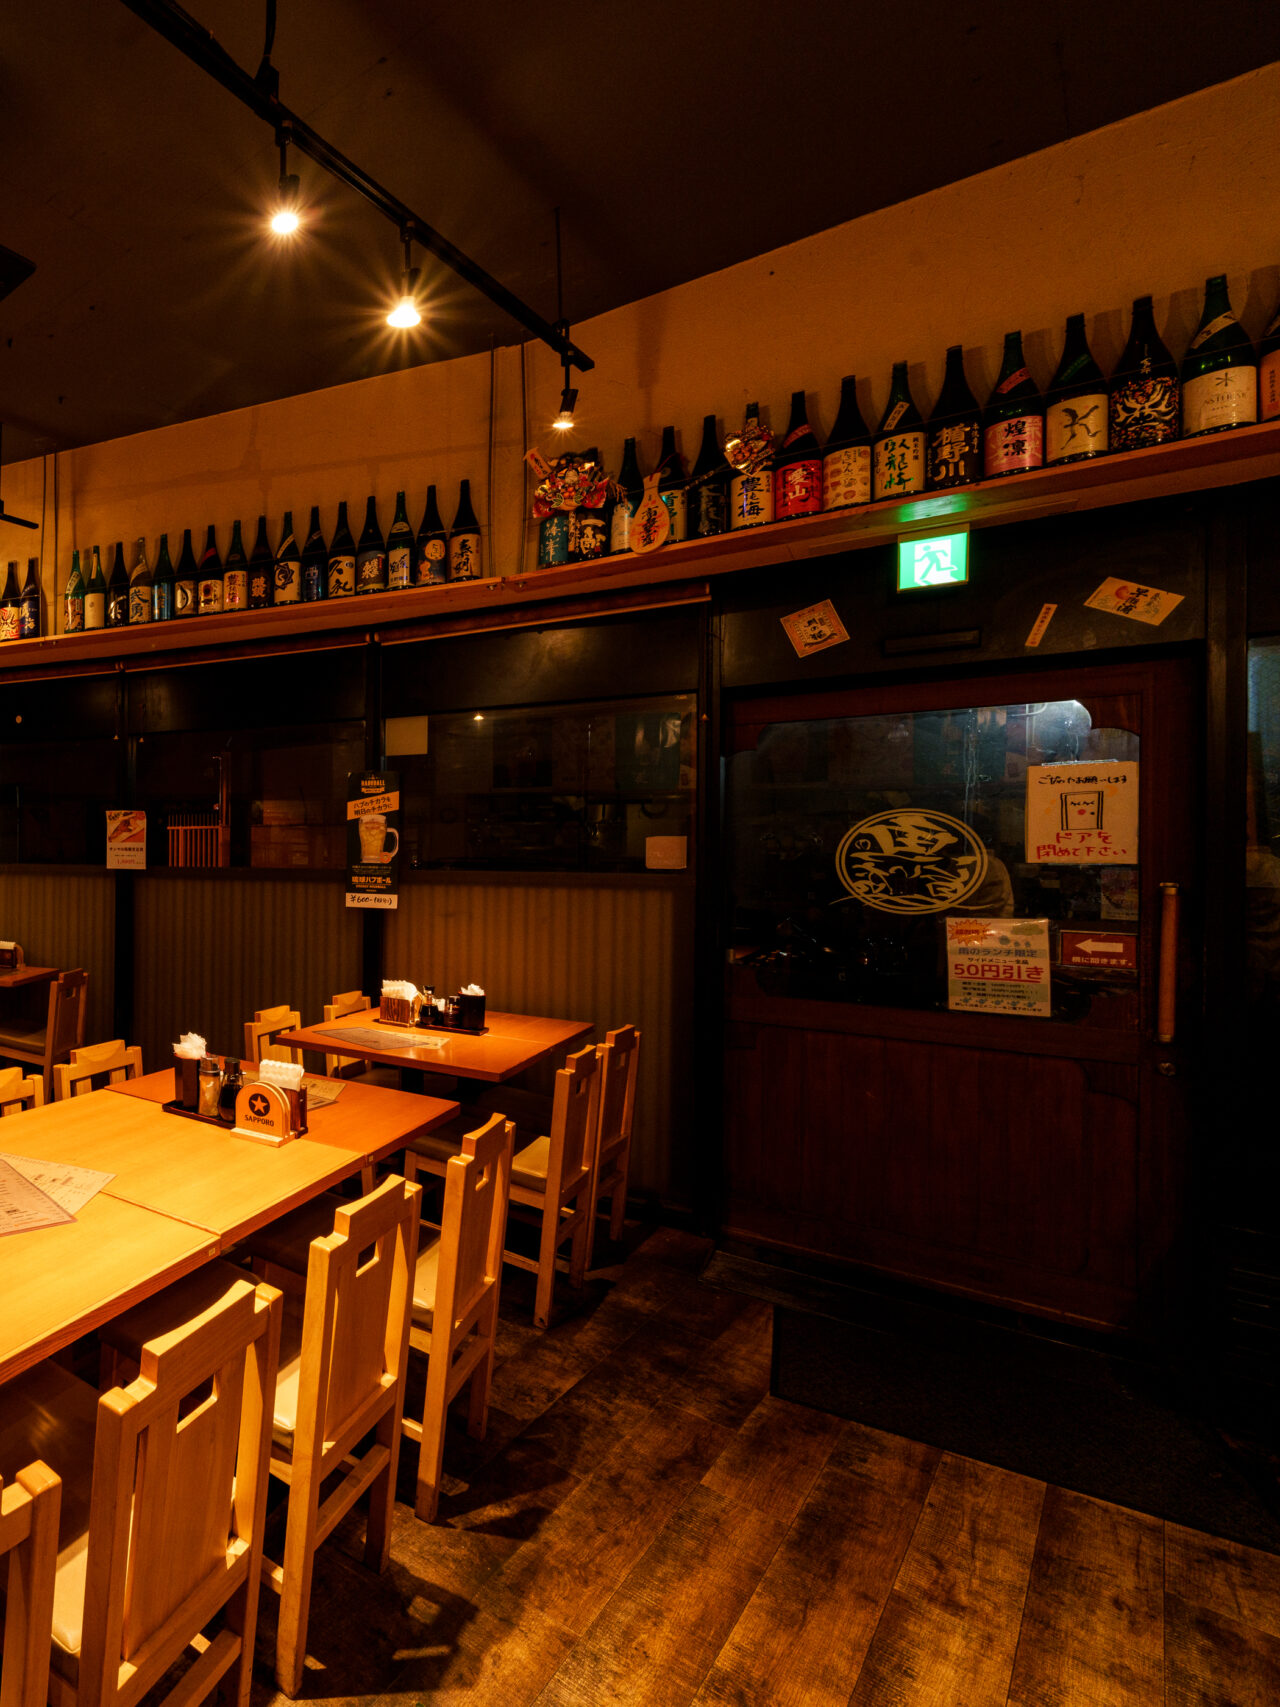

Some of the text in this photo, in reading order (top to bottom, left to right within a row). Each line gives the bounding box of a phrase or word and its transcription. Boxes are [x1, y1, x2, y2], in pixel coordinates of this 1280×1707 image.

[1056, 831, 1112, 844] ドアを
[1036, 844, 1127, 859] 閉めて下さい
[958, 947, 1038, 958] 雨のランチ限定
[954, 963, 1044, 980] 50円引き
[245, 1114, 275, 1127] SAPPORO
